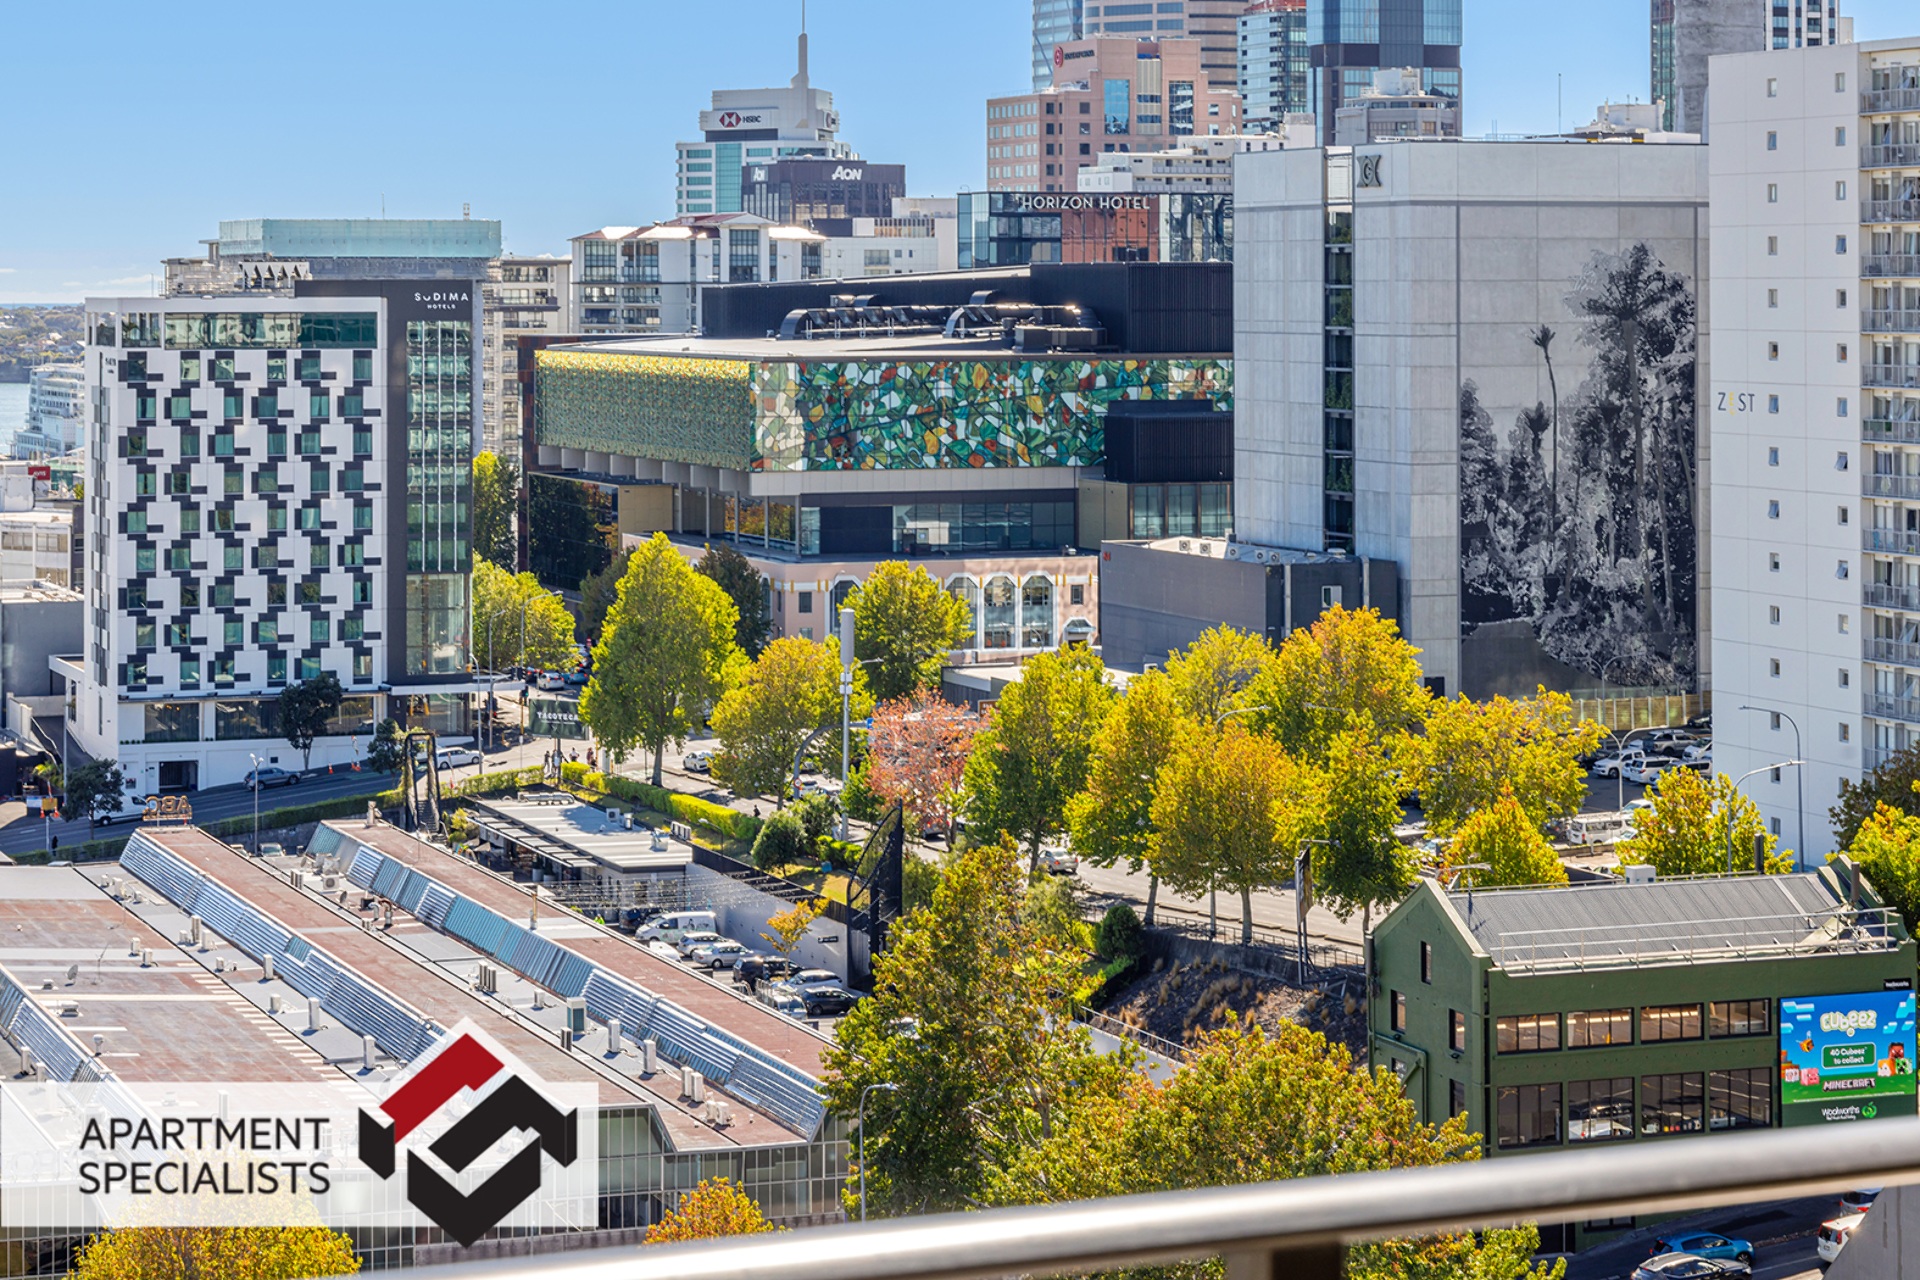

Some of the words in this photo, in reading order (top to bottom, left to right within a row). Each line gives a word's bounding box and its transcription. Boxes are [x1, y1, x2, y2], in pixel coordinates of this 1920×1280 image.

[742, 115, 762, 123] HSBC
[1022, 195, 1093, 209] HORIZON
[1100, 195, 1151, 209] HOTEL
[1717, 391, 1755, 413] ZEST
[1833, 1057, 1841, 1065] to
[1841, 1056, 1865, 1064] collect
[1823, 1078, 1876, 1091] MINECRAFT
